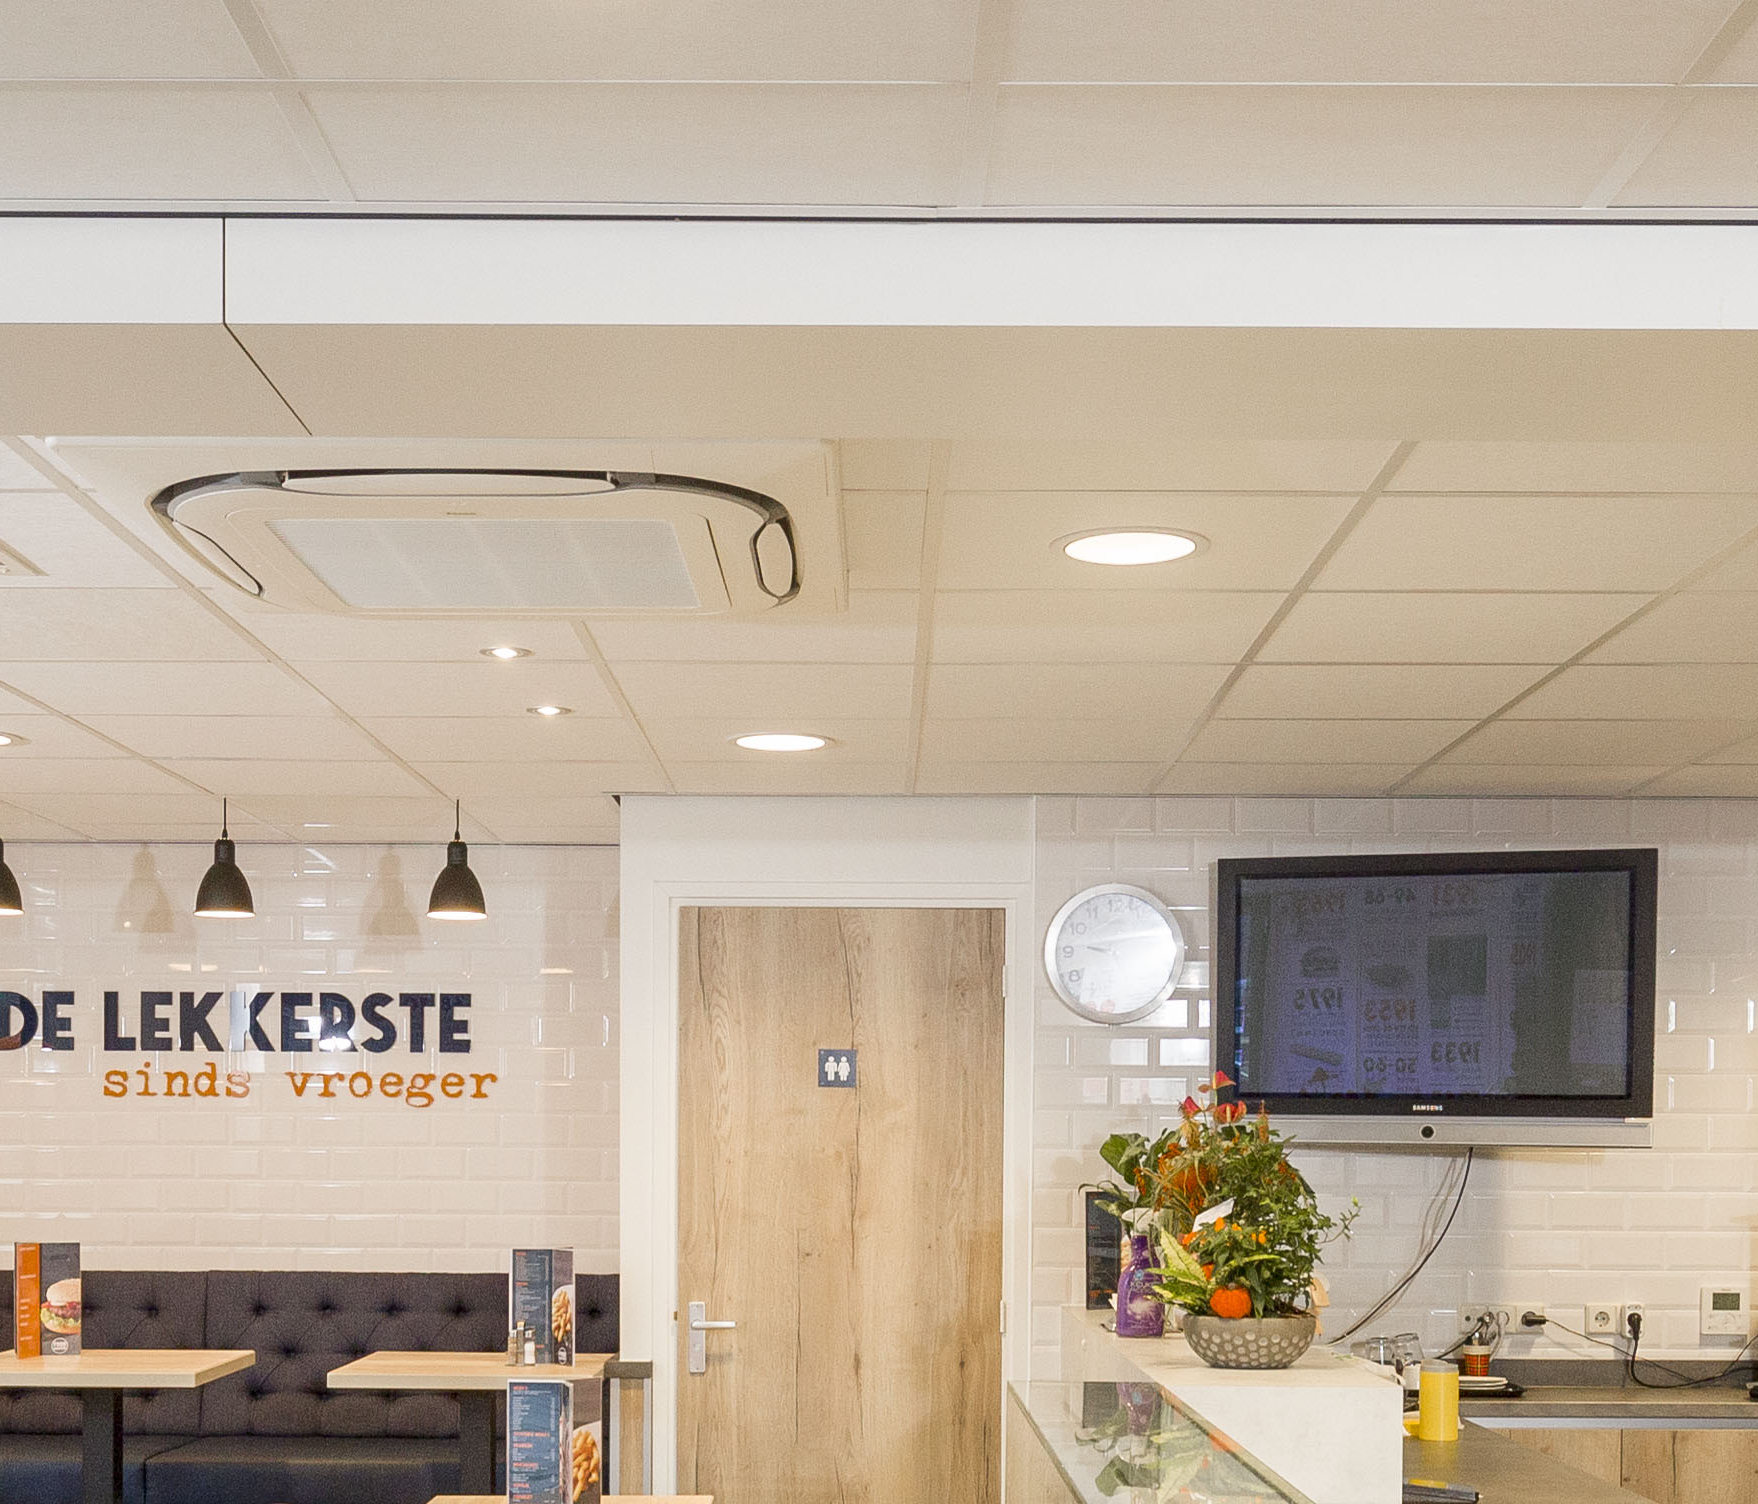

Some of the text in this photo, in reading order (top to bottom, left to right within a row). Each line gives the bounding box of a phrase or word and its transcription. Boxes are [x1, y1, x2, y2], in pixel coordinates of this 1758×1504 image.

[1069, 922, 1088, 936] 10
[1062, 945, 1075, 959] 9
[1068, 969, 1081, 983] 8
[103, 991, 472, 1054] LEKKERSTE
[102, 1062, 499, 1108] sinds vroeger
